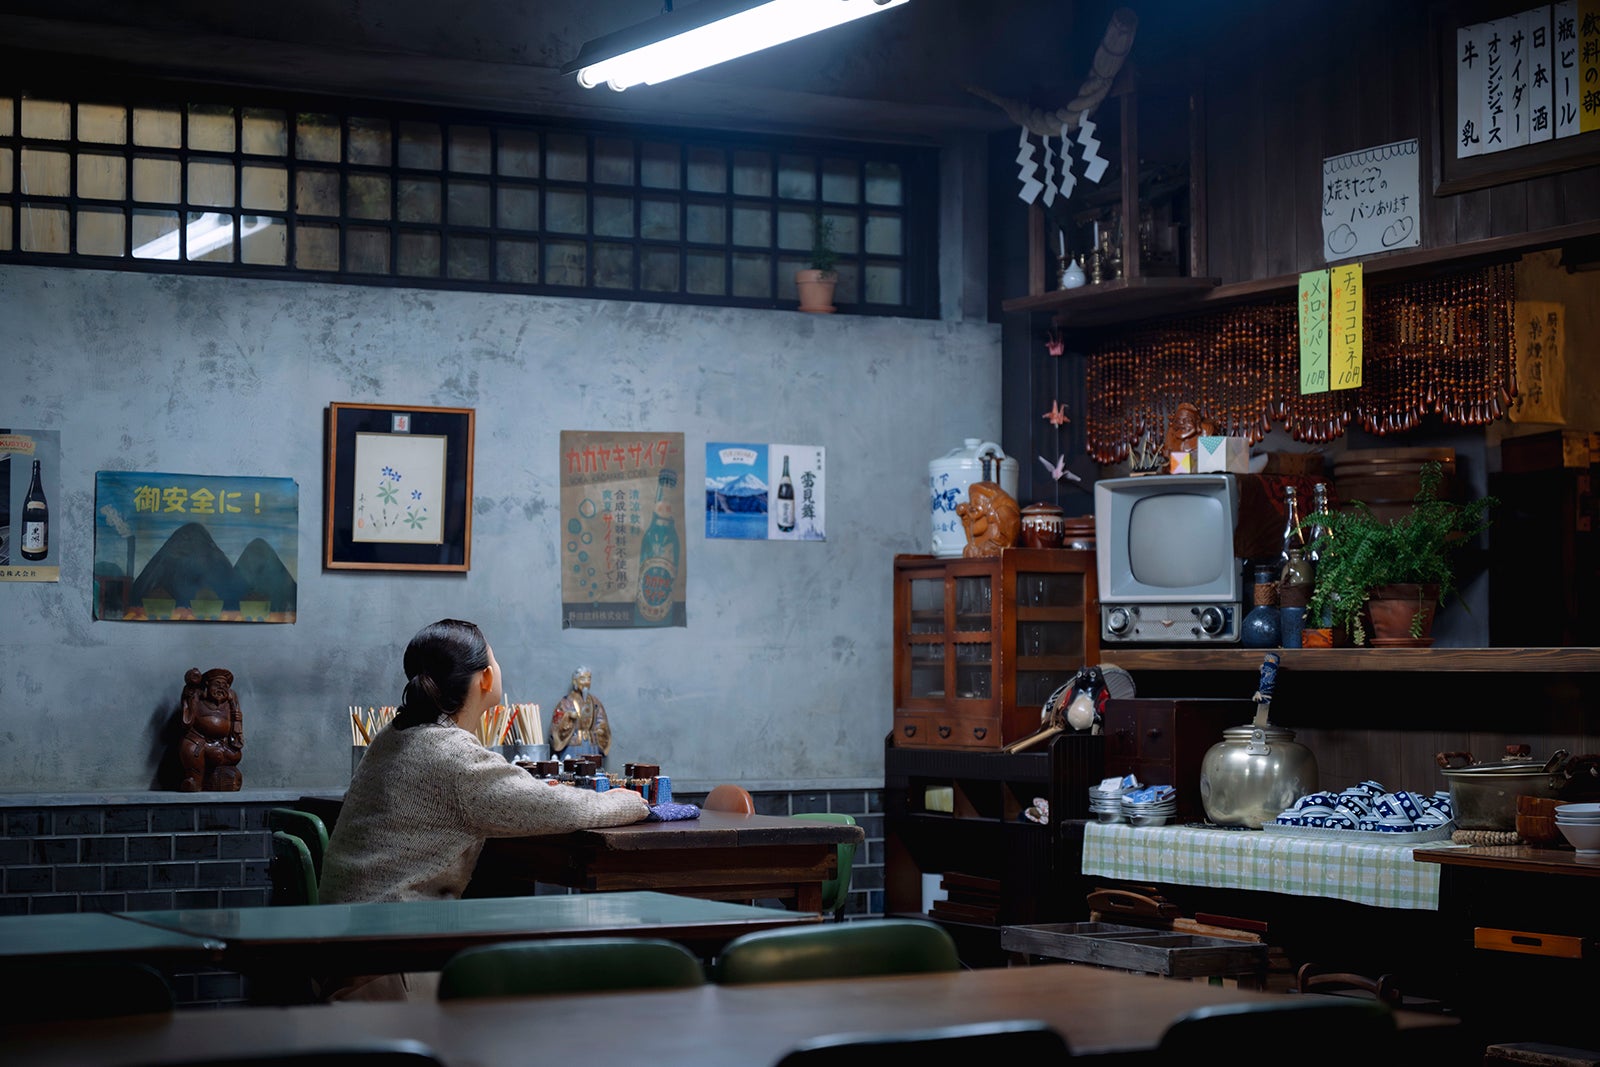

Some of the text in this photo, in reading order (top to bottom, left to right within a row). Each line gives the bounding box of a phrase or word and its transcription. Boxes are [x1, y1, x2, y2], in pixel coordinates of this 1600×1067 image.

[1461, 40, 1480, 147] 牛乳
[1487, 32, 1504, 145] オレンジジュース
[1510, 30, 1527, 134] サイダー
[1532, 26, 1549, 132] 日本酒
[1558, 17, 1577, 127] 瓶ビール
[1581, 12, 1600, 116] 飲料の部
[1327, 176, 1388, 205] 焼きたての
[1309, 276, 1323, 366] メロンパン
[1343, 271, 1357, 370] チョココロネ
[1305, 369, 1325, 387] 10円
[1338, 366, 1361, 385] 10円
[566, 441, 679, 474] カガヤキサイダー
[800, 470, 817, 521] 雪見舞
[615, 489, 627, 590] 合成甘味料不使用の
